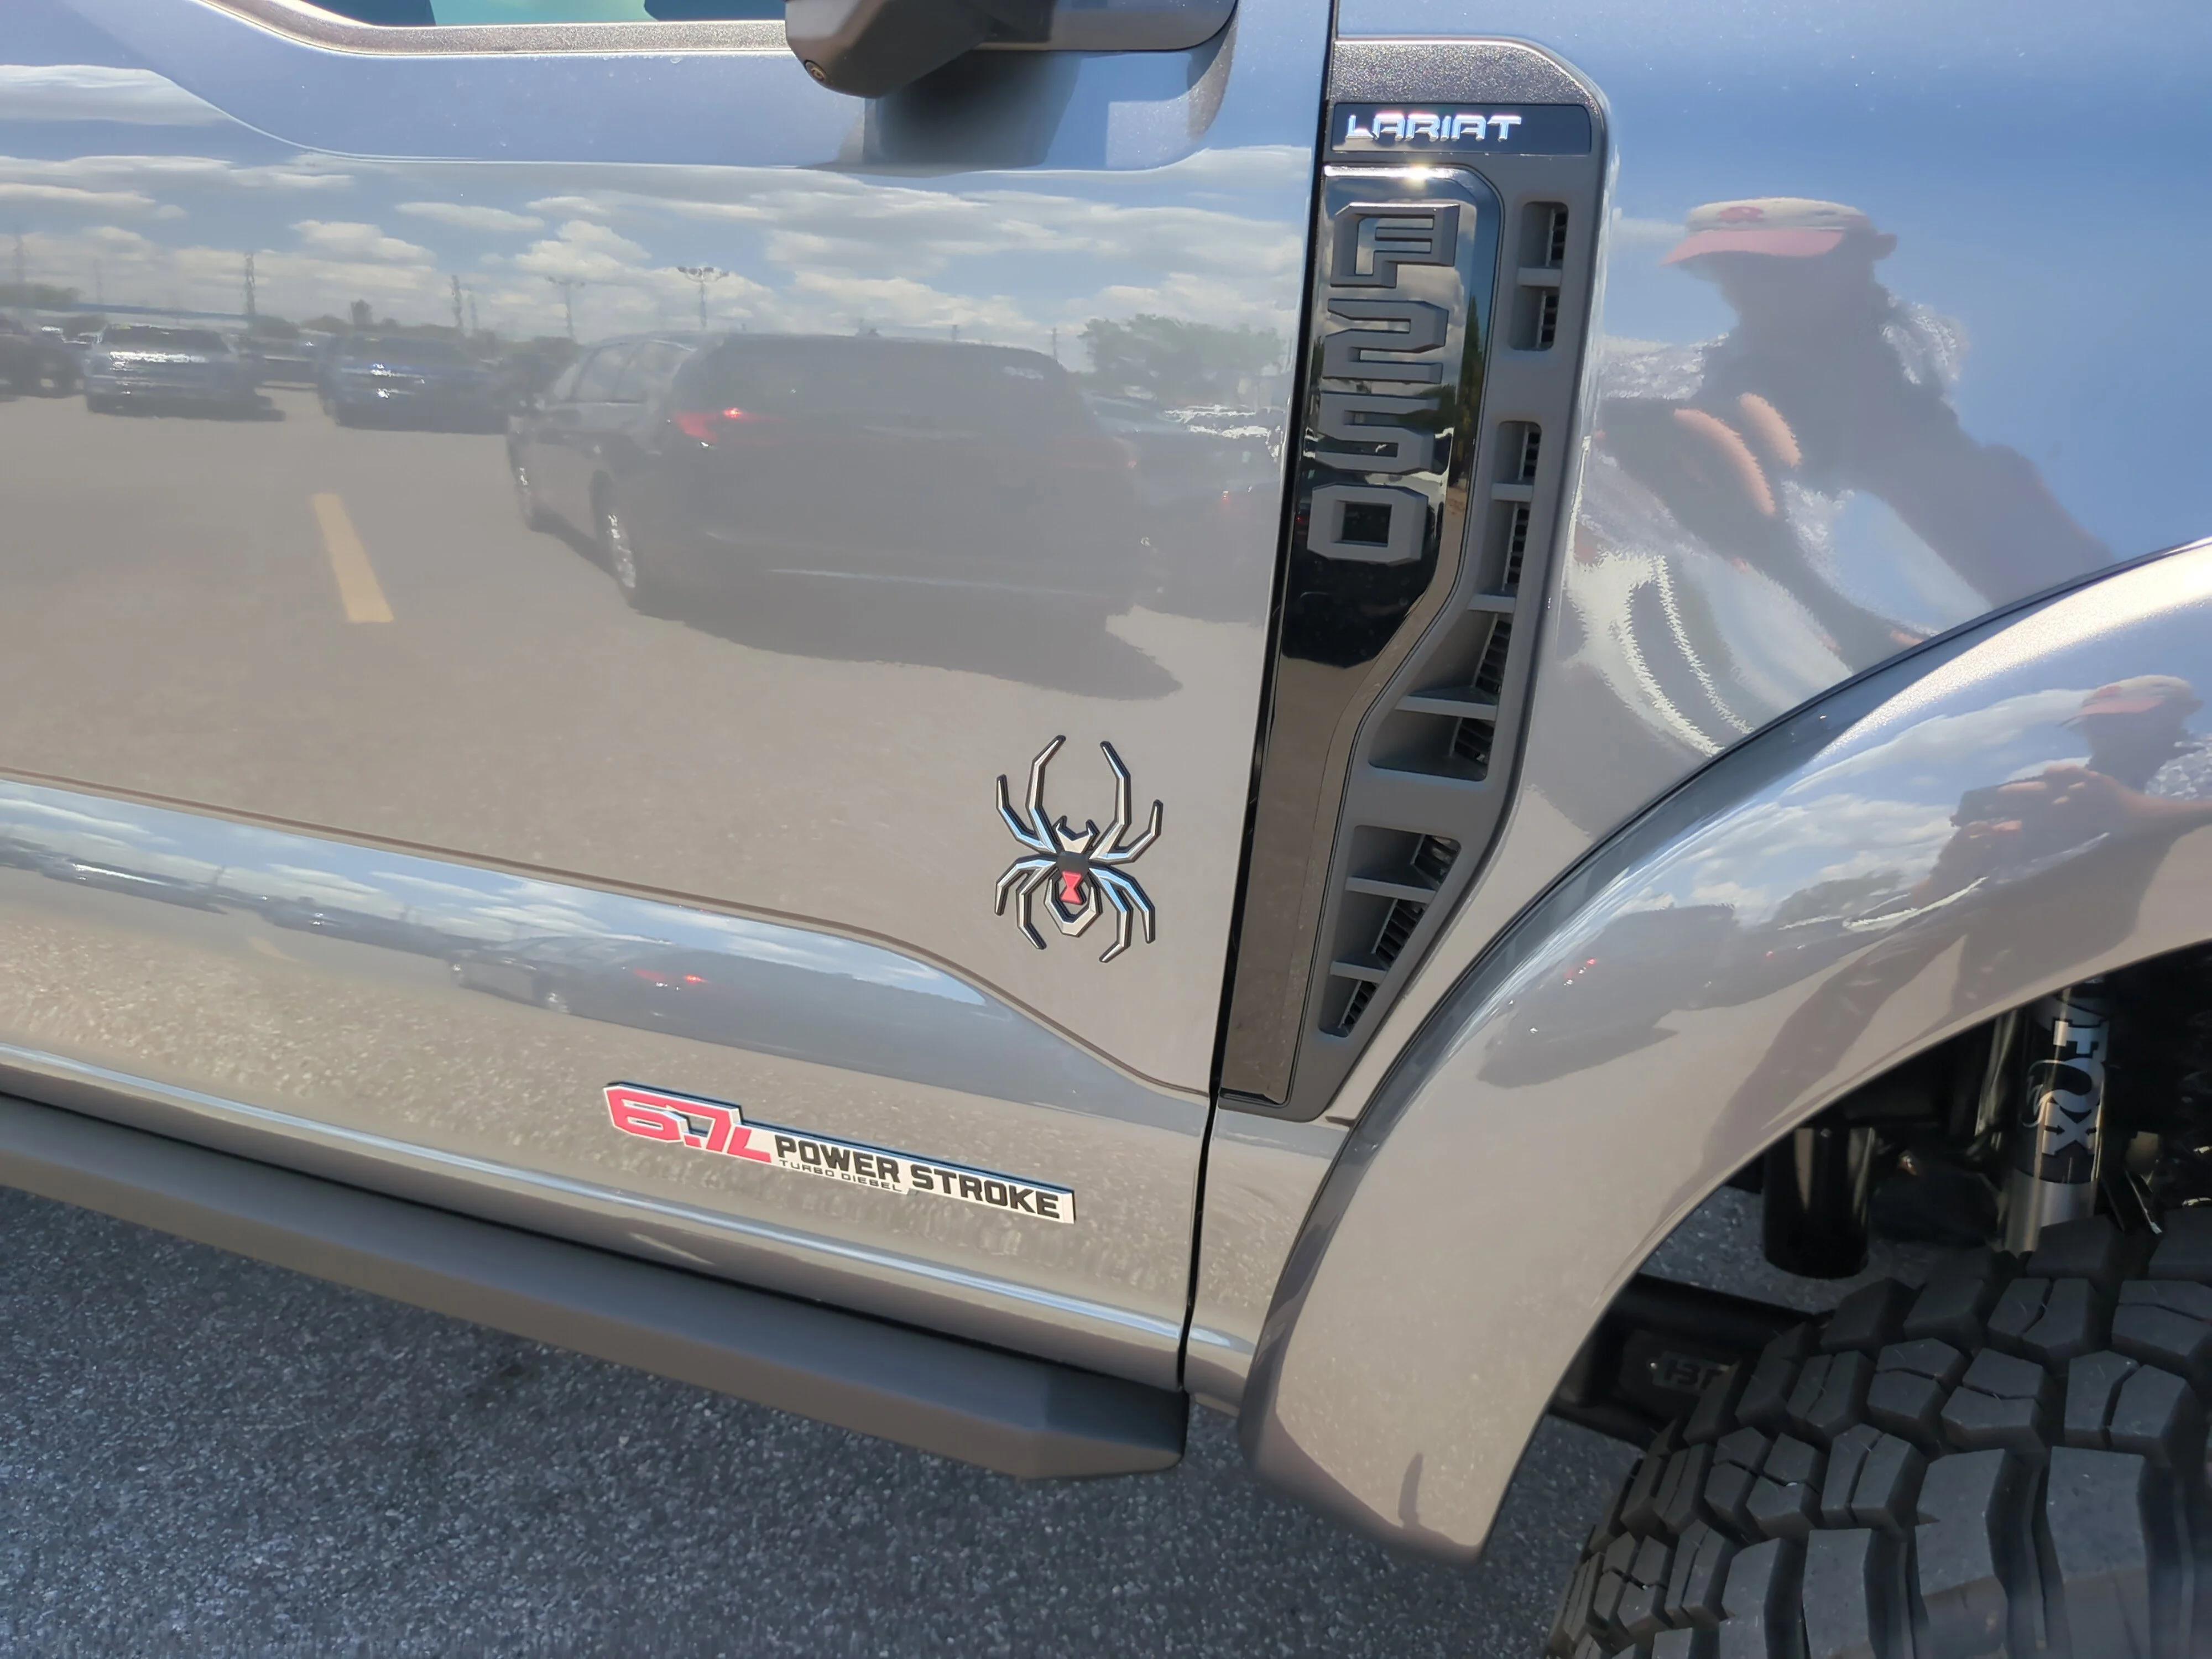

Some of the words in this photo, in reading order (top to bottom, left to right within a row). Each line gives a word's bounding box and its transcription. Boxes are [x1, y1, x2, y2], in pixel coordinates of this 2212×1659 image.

[1345, 113, 1522, 142] LARIAT
[1307, 202, 1460, 565] F250
[2022, 1018, 2109, 1156] FOX
[774, 1134, 900, 1183] POWER
[910, 1164, 1060, 1219] STROKE
[779, 1159, 835, 1177] TURBO
[841, 1173, 902, 1192] DIESEL
